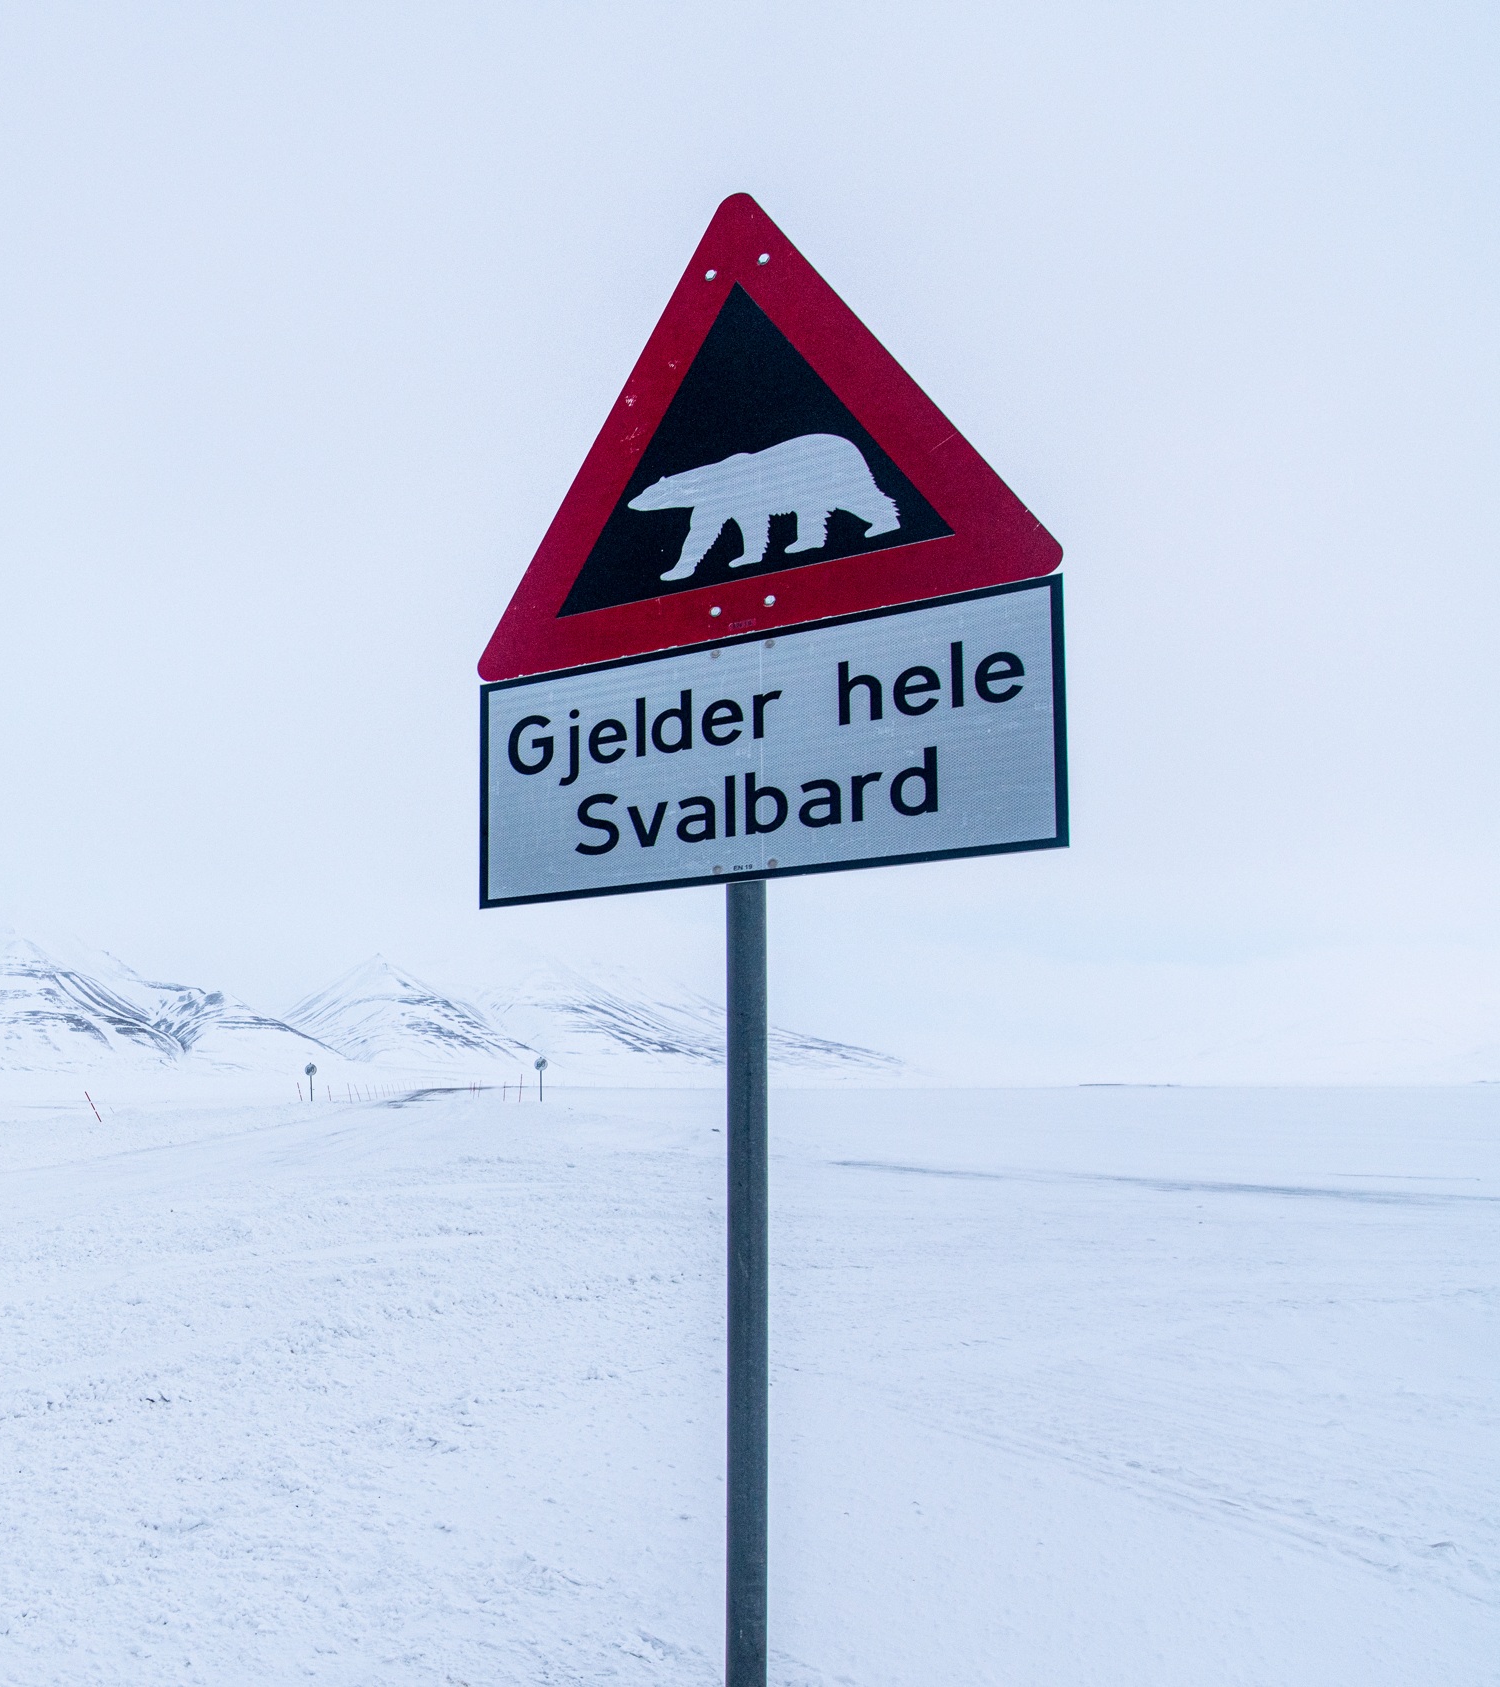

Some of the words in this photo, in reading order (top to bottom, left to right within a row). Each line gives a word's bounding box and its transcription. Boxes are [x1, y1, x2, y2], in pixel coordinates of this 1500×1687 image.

[507, 688, 783, 787] Gjelder
[837, 640, 1026, 727] hele
[575, 745, 940, 856] Svalbard
